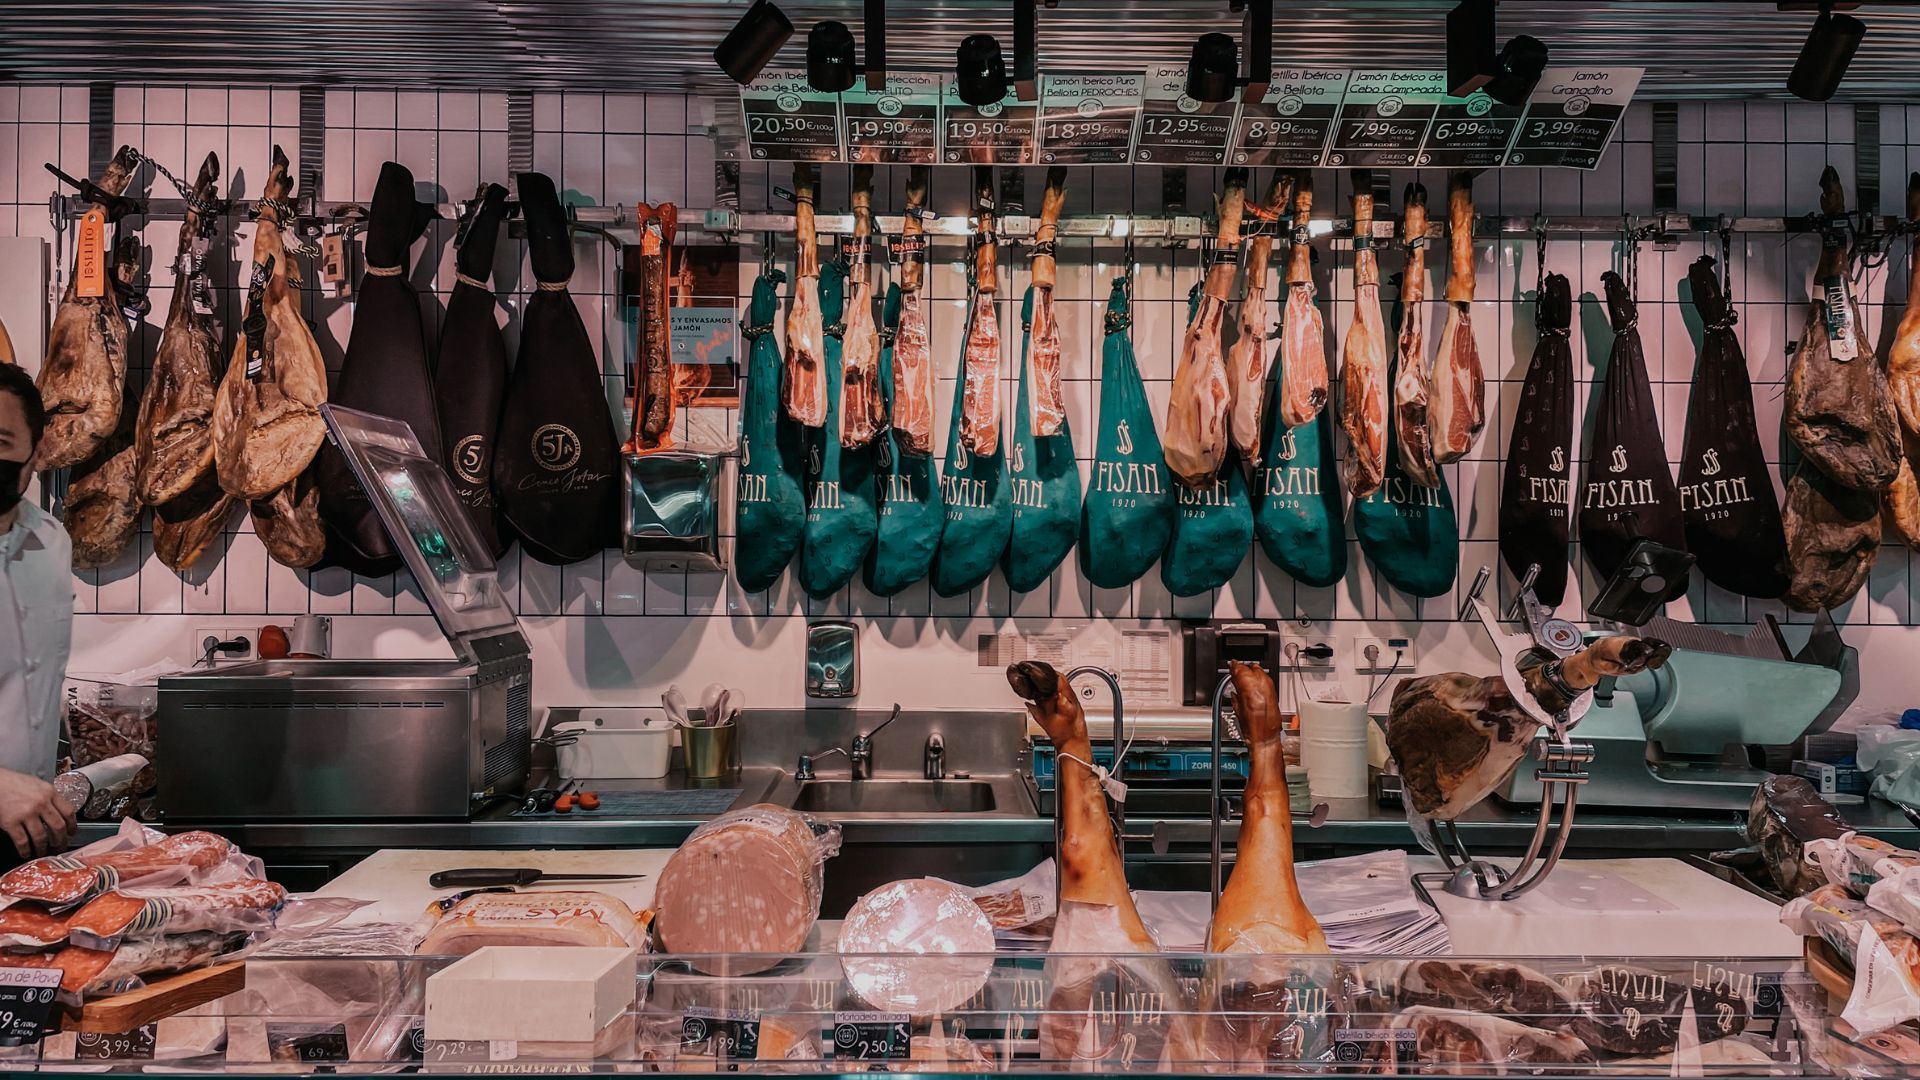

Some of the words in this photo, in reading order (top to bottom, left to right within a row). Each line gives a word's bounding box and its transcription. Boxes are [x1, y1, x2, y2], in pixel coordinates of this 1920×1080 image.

[886, 75, 931, 85] elección
[1301, 70, 1343, 81] Ibérica
[1356, 73, 1389, 82] Jamón
[1390, 72, 1425, 81] Ibérico
[1428, 73, 1444, 82] de
[1571, 71, 1609, 81] Jamón
[1052, 77, 1079, 86] Jamón
[1116, 77, 1135, 85] Puro
[744, 84, 769, 92] Puro
[775, 83, 789, 92] de
[1047, 88, 1079, 96] Bellota
[1081, 88, 1139, 96] PEDROCHES
[1162, 82, 1180, 92] de
[1283, 84, 1325, 96] Bellota
[1350, 84, 1380, 94] Cebo
[1551, 84, 1614, 96] Granadino
[1096, 462, 1162, 494] FISAN
[1252, 467, 1321, 496] FISAN
[808, 480, 840, 509] SAN
[1584, 478, 1656, 509] FISAN
[1679, 476, 1751, 512] FISAN
[1112, 499, 1136, 508] 1920
[1273, 500, 1299, 510] 1920
[1183, 509, 1206, 519] 1920
[1394, 509, 1422, 518] 1920
[1607, 513, 1619, 522] 19
[1703, 509, 1730, 521] 1920
[15, 970, 31, 983] de
[33, 970, 60, 984] Pavo
[837, 1013, 877, 1021] Mortadela
[98, 1039, 131, 1059] 3,99
[858, 1040, 888, 1060] 2,50
